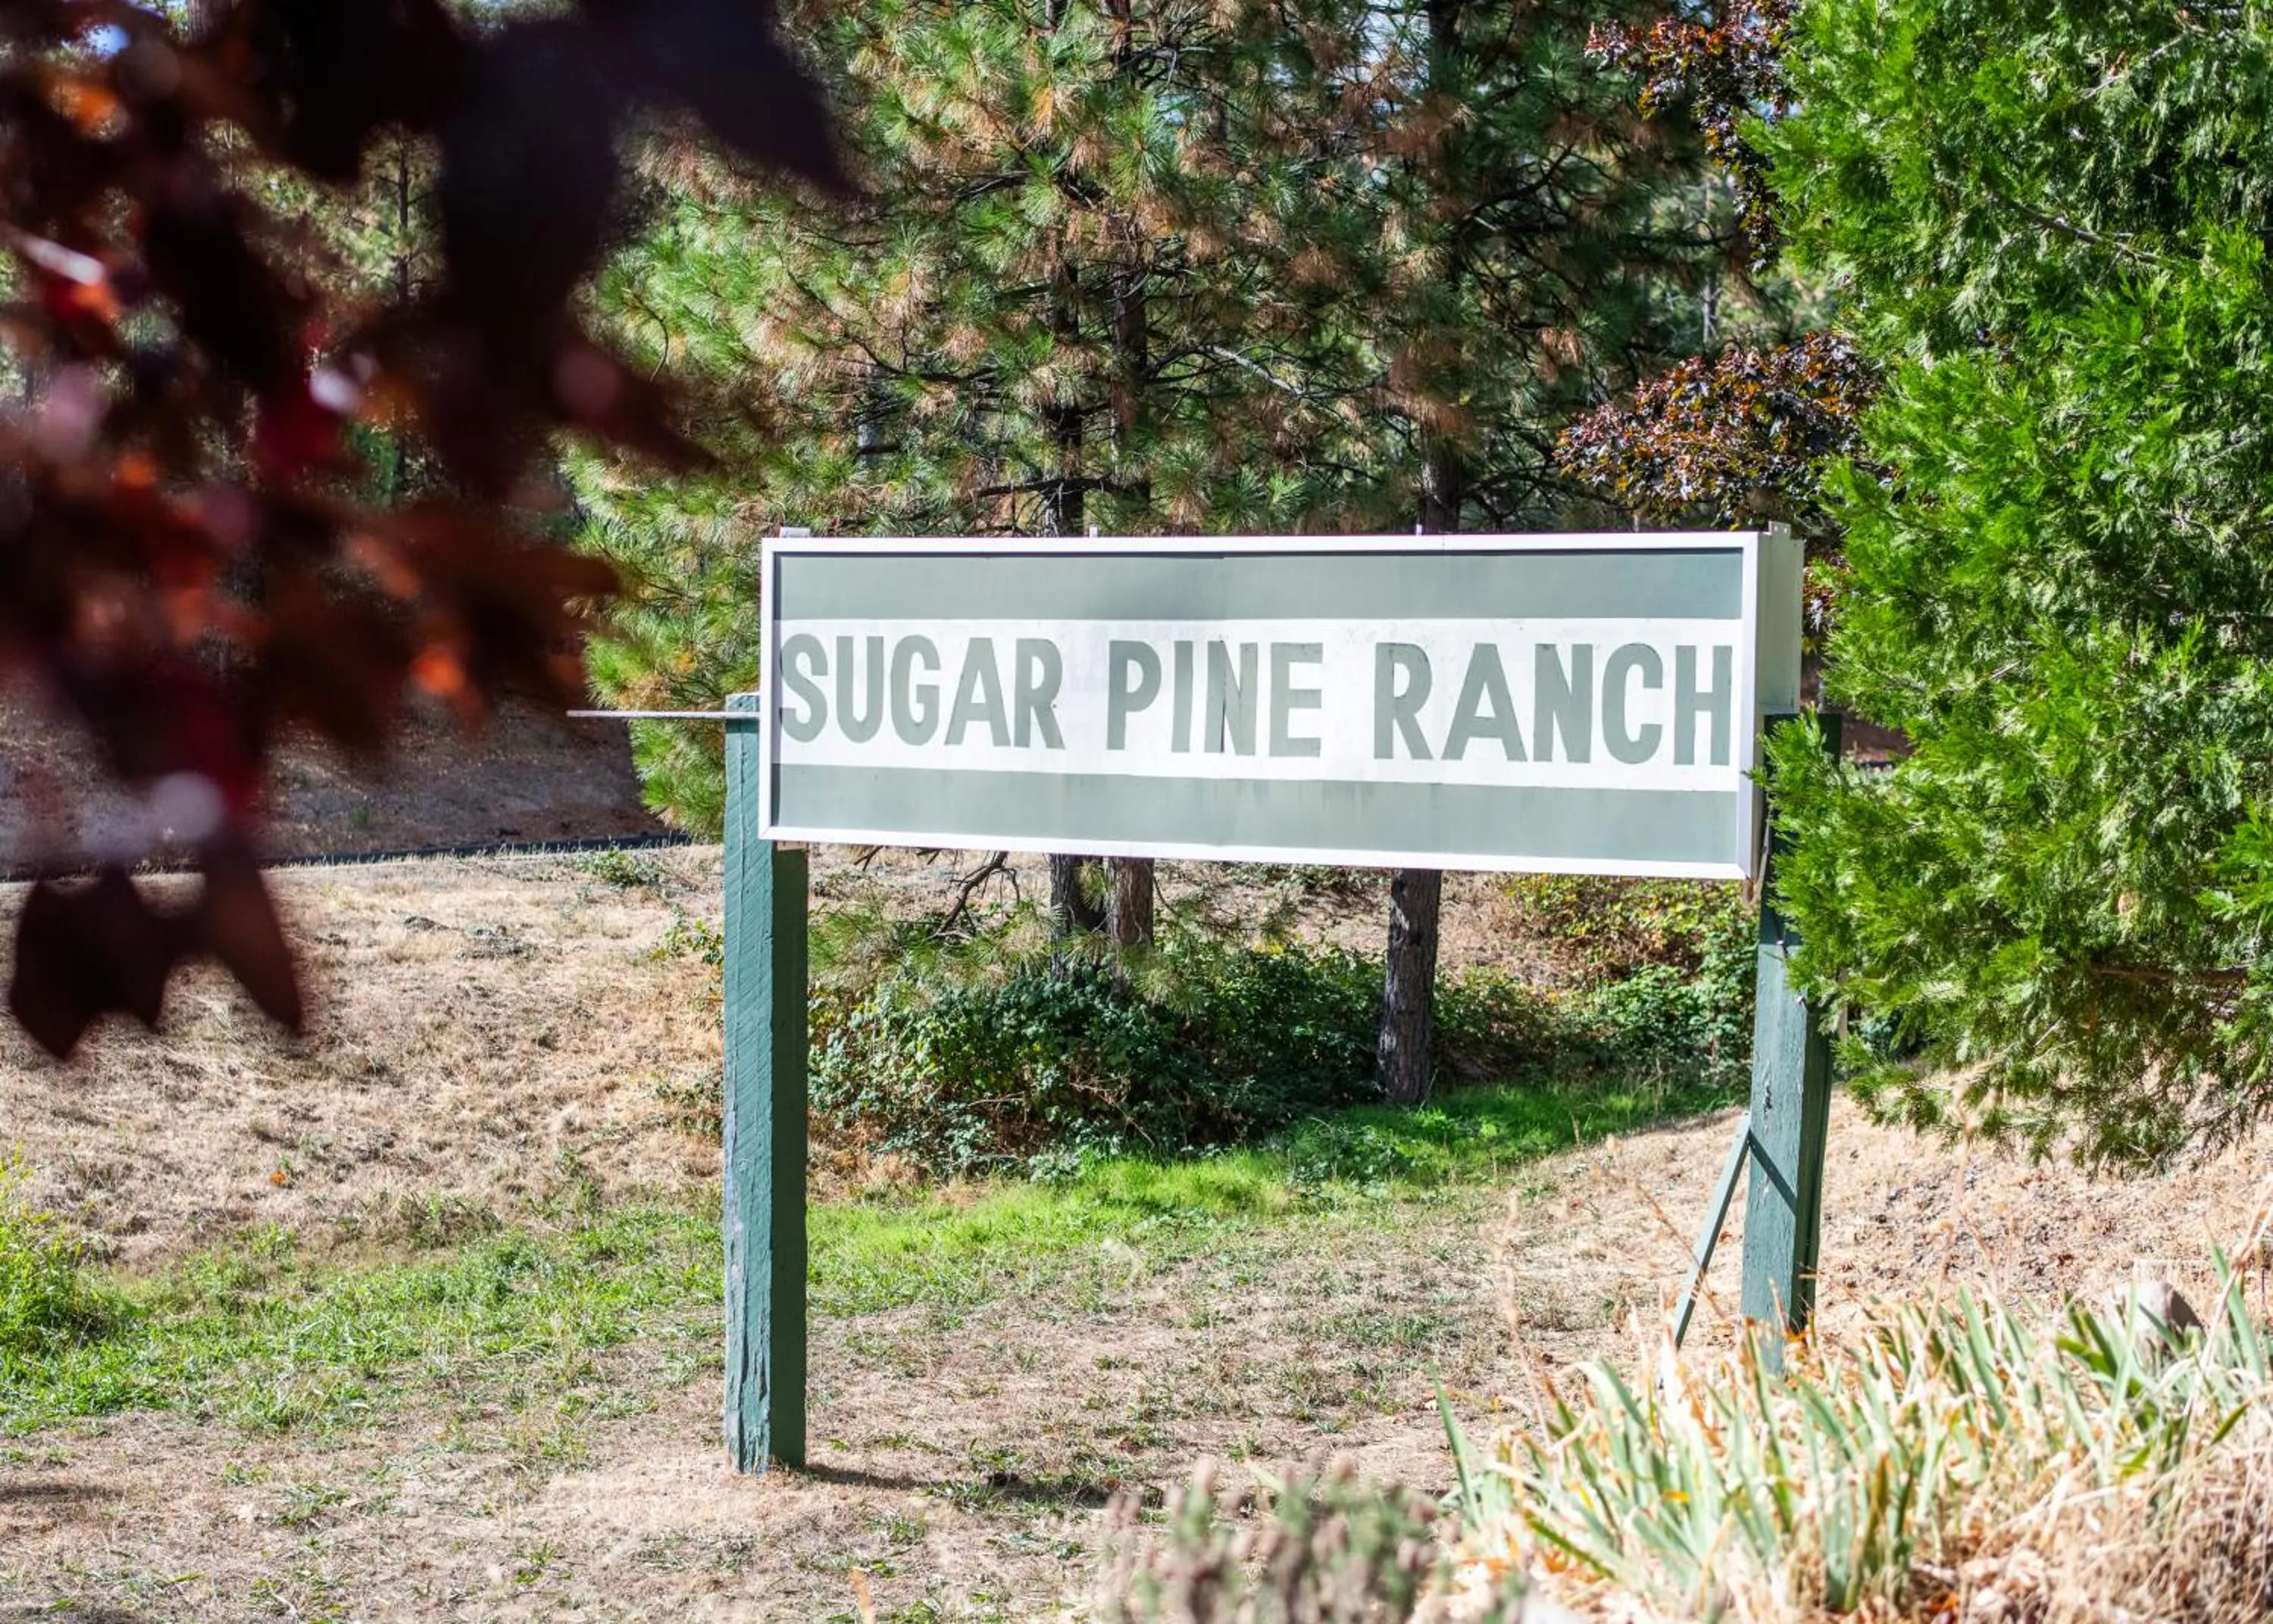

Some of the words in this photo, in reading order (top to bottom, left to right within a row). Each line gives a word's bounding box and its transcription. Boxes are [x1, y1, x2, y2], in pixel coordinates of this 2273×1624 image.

[779, 633, 1065, 749] SUGAR
[1107, 640, 1323, 757] PINE
[1373, 642, 1733, 766] RANCH
